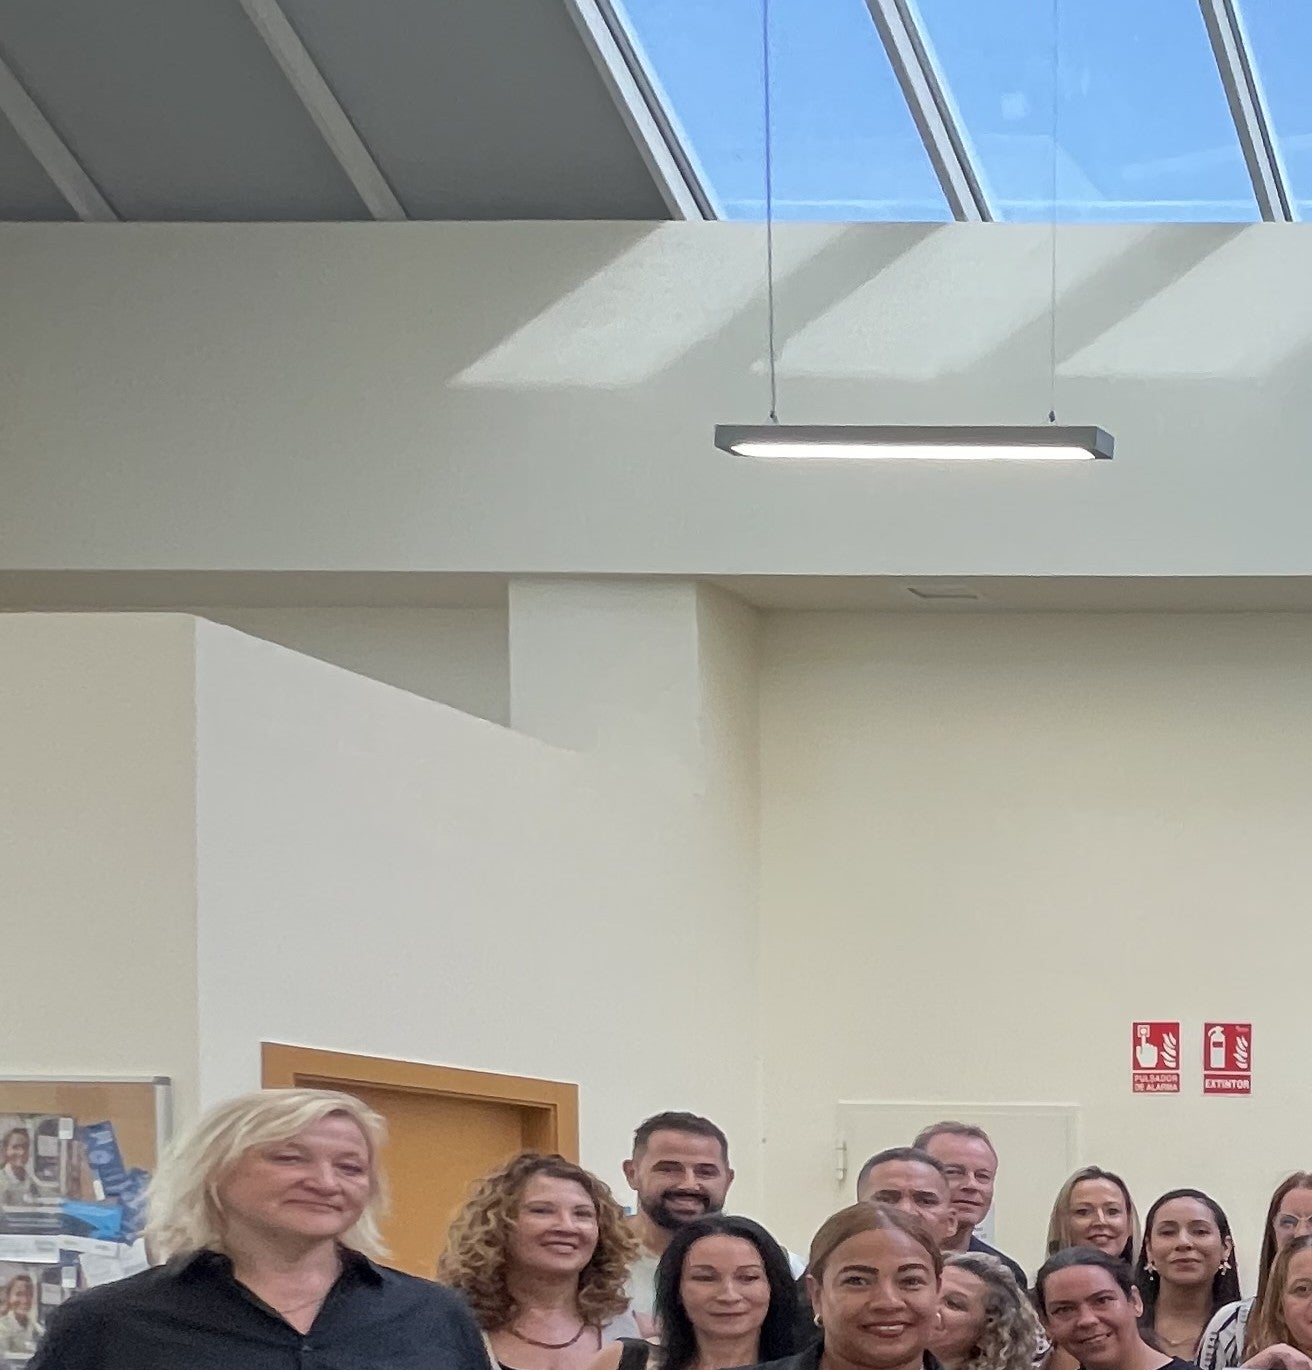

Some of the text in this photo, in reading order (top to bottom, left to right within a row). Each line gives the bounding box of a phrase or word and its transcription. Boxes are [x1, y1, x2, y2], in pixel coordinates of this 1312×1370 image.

[1134, 1074, 1178, 1082] PULSADOR
[1134, 1083, 1145, 1092] DE
[1205, 1079, 1250, 1089] EXTINTOR
